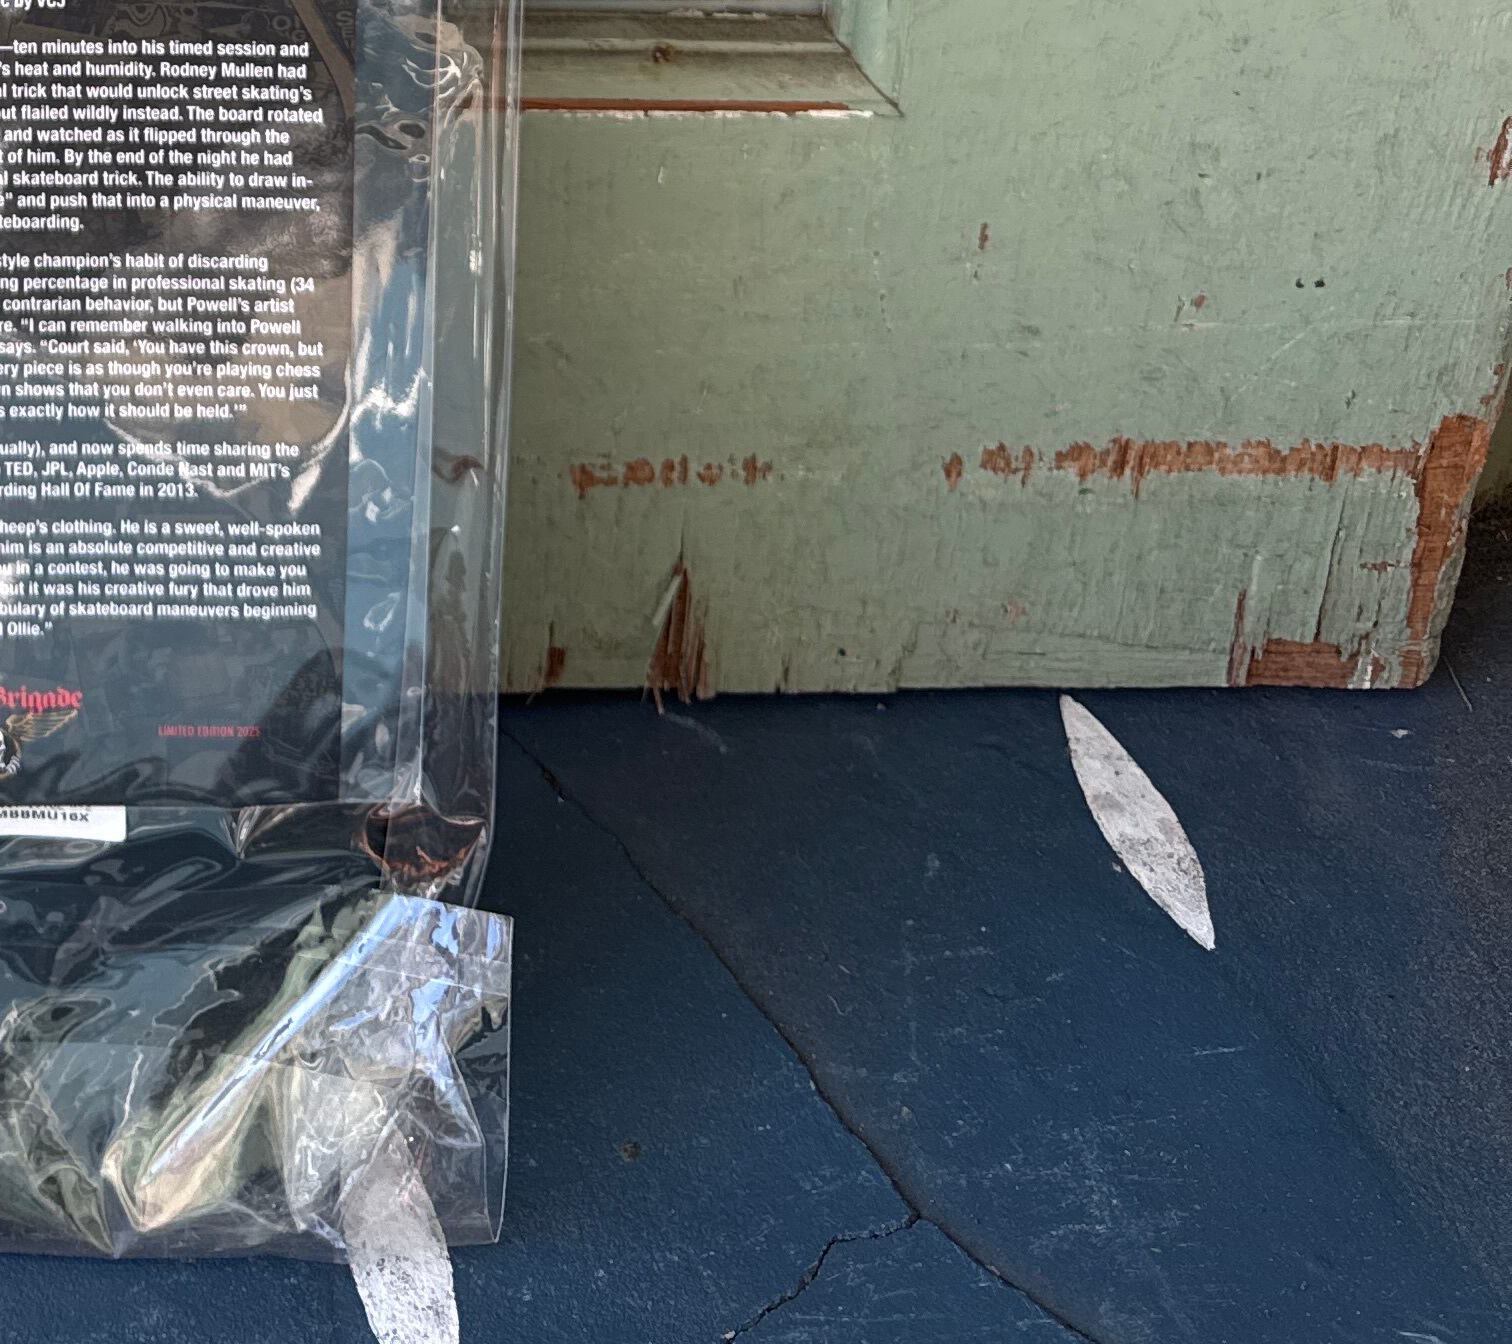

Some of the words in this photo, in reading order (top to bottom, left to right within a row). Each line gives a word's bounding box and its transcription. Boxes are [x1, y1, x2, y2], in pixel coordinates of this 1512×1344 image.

[41, 38, 104, 55] minutes
[107, 38, 138, 55] into
[141, 39, 166, 55] his
[168, 39, 214, 56] timed
[216, 40, 276, 57] session
[279, 41, 310, 58] and
[33, 251, 122, 272] champion's
[125, 252, 165, 269] habit
[167, 252, 184, 268] of
[187, 252, 268, 273] discarding
[40, 480, 71, 498] Hall
[73, 481, 91, 497] Of
[93, 480, 136, 498] Fame
[138, 481, 154, 497] in
[156, 477, 199, 499] 2013.
[158, 725, 194, 737] LIMITED
[197, 725, 234, 737] EDITION
